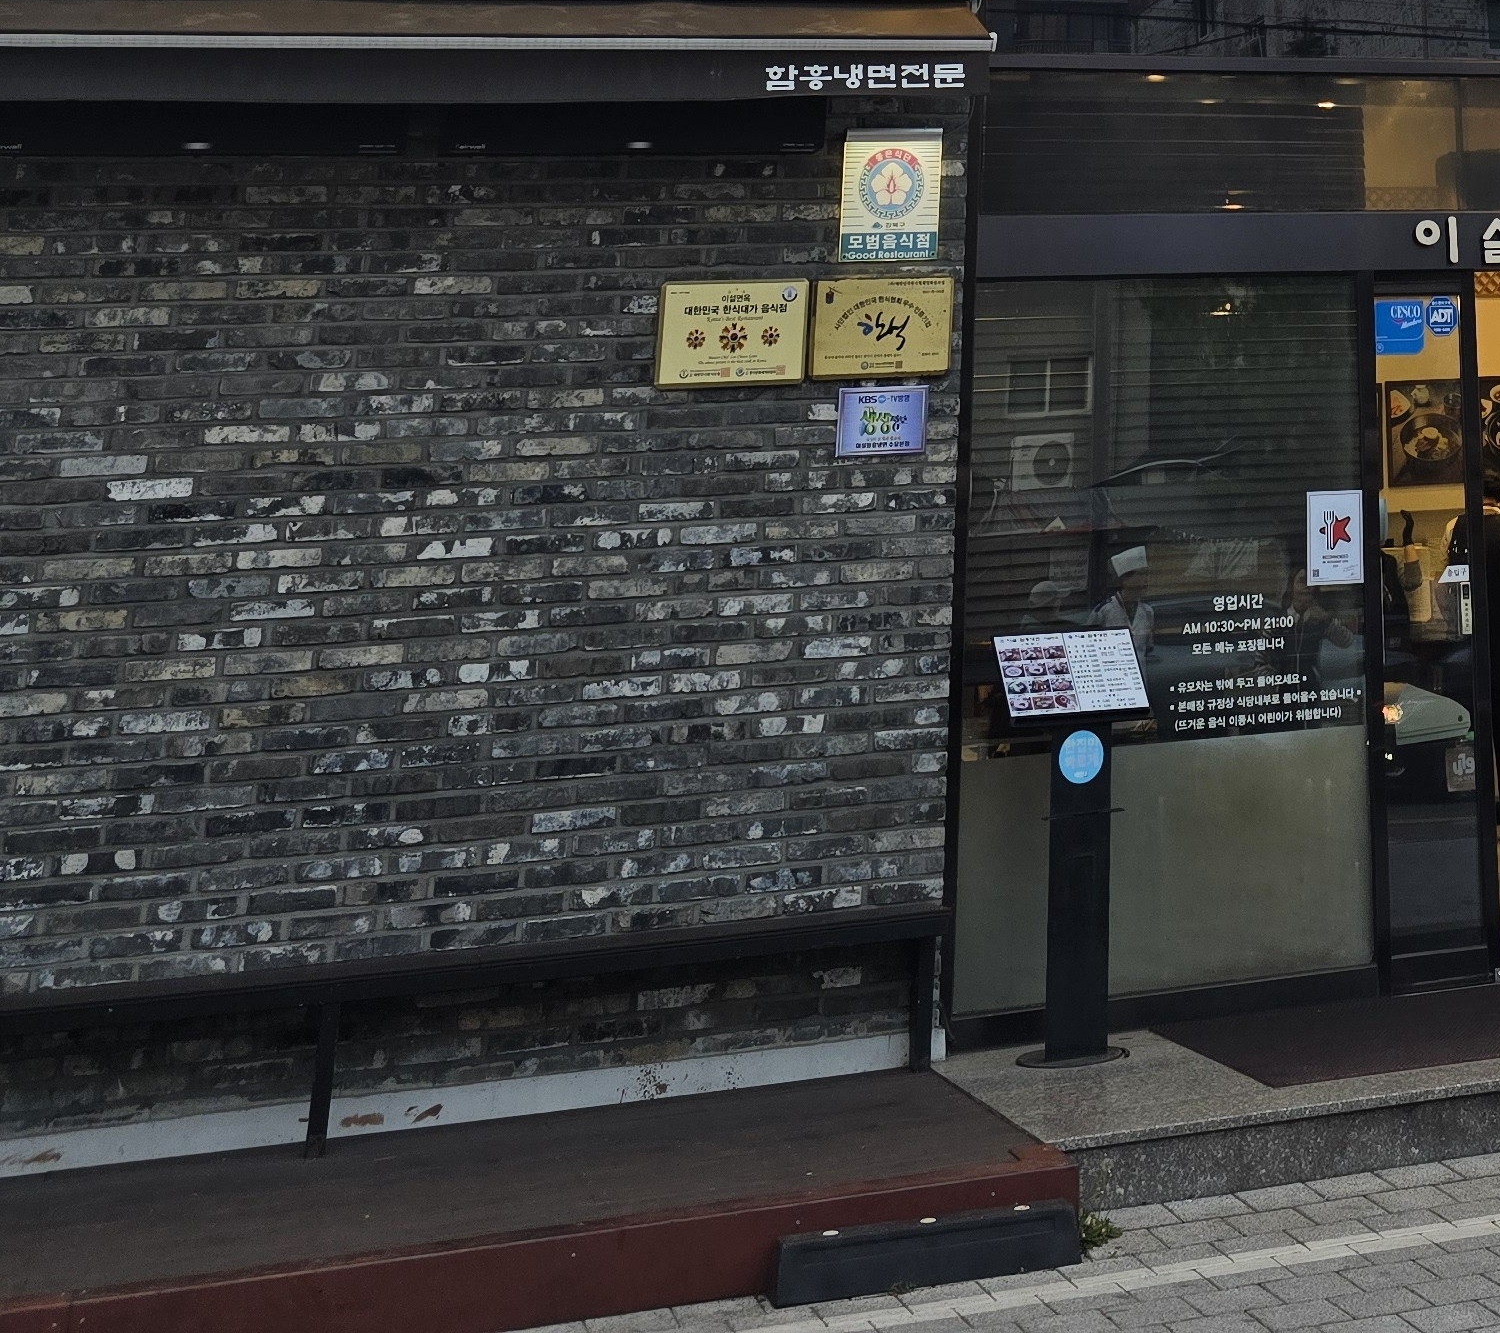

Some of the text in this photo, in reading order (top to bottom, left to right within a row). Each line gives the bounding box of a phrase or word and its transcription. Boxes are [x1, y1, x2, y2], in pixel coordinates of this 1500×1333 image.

[765, 63, 966, 90] 함흥냉면전문
[847, 233, 931, 250] 모범음식점
[848, 250, 929, 261] Good Restaurant
[721, 294, 751, 303] 이설면옥
[684, 303, 788, 316] 대한민국 한식대가 음식점
[1391, 305, 1420, 319] CESCO
[1431, 309, 1453, 323] ADT
[859, 396, 877, 404] KBS
[1213, 593, 1264, 612] 영업시간
[1182, 615, 1294, 635] AM 10:30~PM 21:00
[1192, 637, 1285, 655] 모든 메뉴 포장됩니다
[1177, 673, 1300, 694] 유모차는 밖에 두고 들어오세요
[1207, 697, 1234, 711] 규정상
[1236, 693, 1281, 709] 식당내부로
[1320, 687, 1354, 701] 없습니다
[1174, 705, 1342, 732] (뜨거운 음식 이동시 어린이가 위험합니다)
